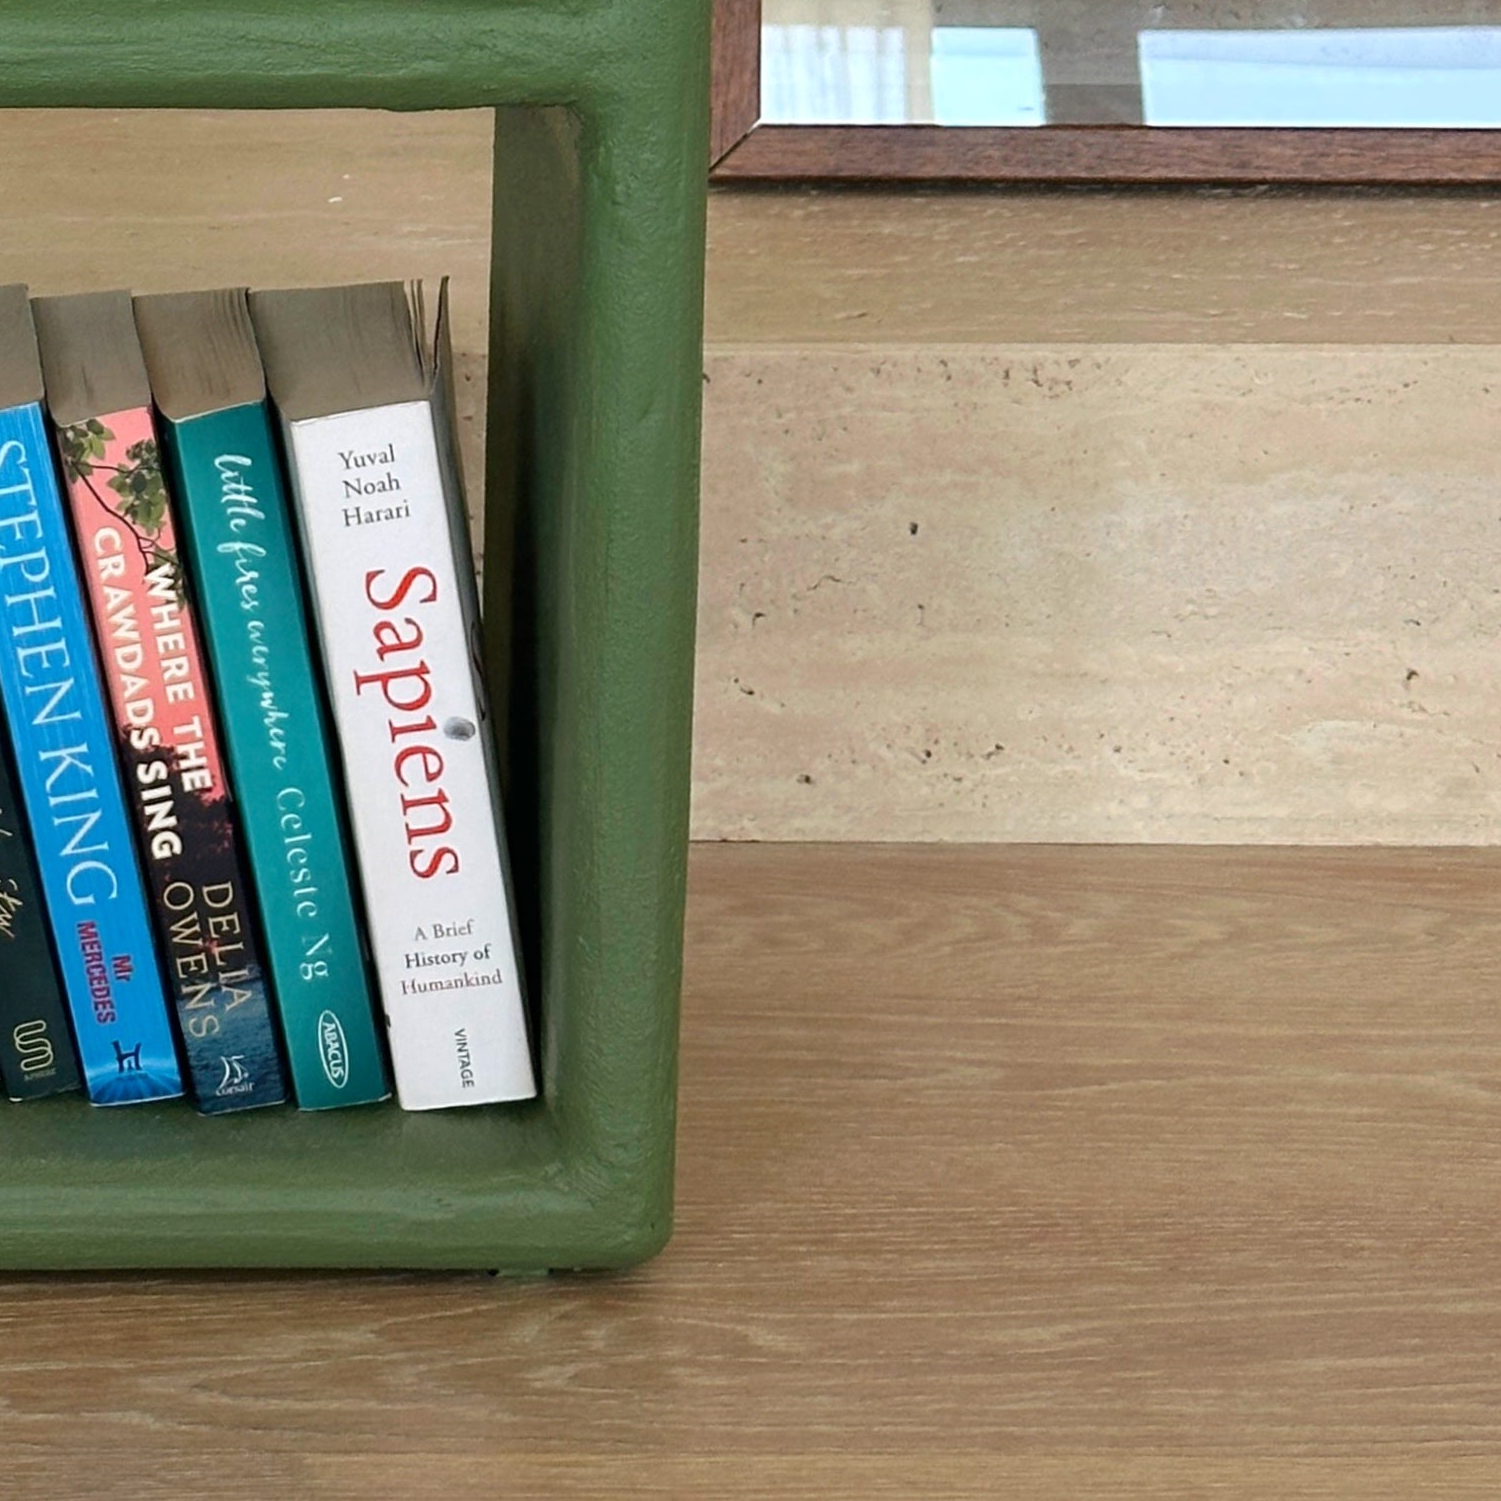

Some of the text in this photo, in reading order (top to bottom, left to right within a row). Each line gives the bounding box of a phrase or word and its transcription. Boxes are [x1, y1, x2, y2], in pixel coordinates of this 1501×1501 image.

[339, 444, 396, 470] Yuval
[342, 473, 401, 498] Noah
[342, 500, 411, 527] Harari
[93, 527, 182, 859] CRAWDADS SING
[145, 563, 213, 793] WHERE THE
[353, 567, 475, 879] Sapiens
[39, 743, 118, 906] KING
[276, 787, 333, 980] Celeste Ng
[163, 881, 220, 1038] OWENS
[203, 881, 252, 1011] DELIA
[405, 944, 491, 969] History of
[414, 919, 474, 941] A Brief
[76, 921, 116, 1025] MERCEDES
[112, 955, 133, 982] Mr
[400, 968, 503, 996] Humankind
[323, 1022, 344, 1080] ABACUS
[454, 1028, 474, 1088] VINTAGE
